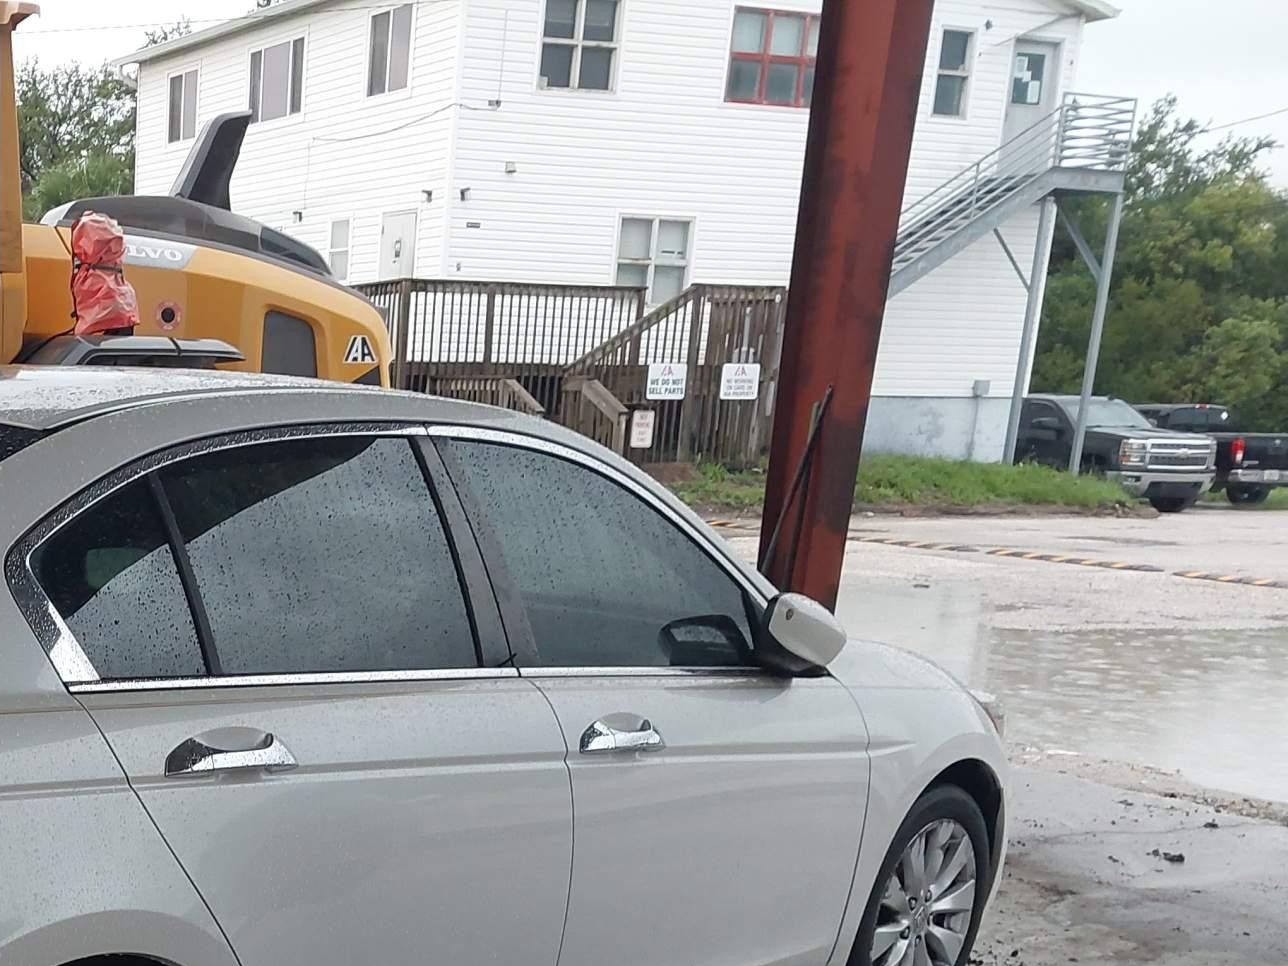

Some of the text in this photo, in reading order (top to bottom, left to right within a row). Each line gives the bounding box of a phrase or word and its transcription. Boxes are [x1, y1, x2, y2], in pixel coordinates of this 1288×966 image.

[125, 243, 183, 262] LVO
[650, 378, 684, 386] WE DO NOT
[648, 387, 684, 396] SELL PARTS
